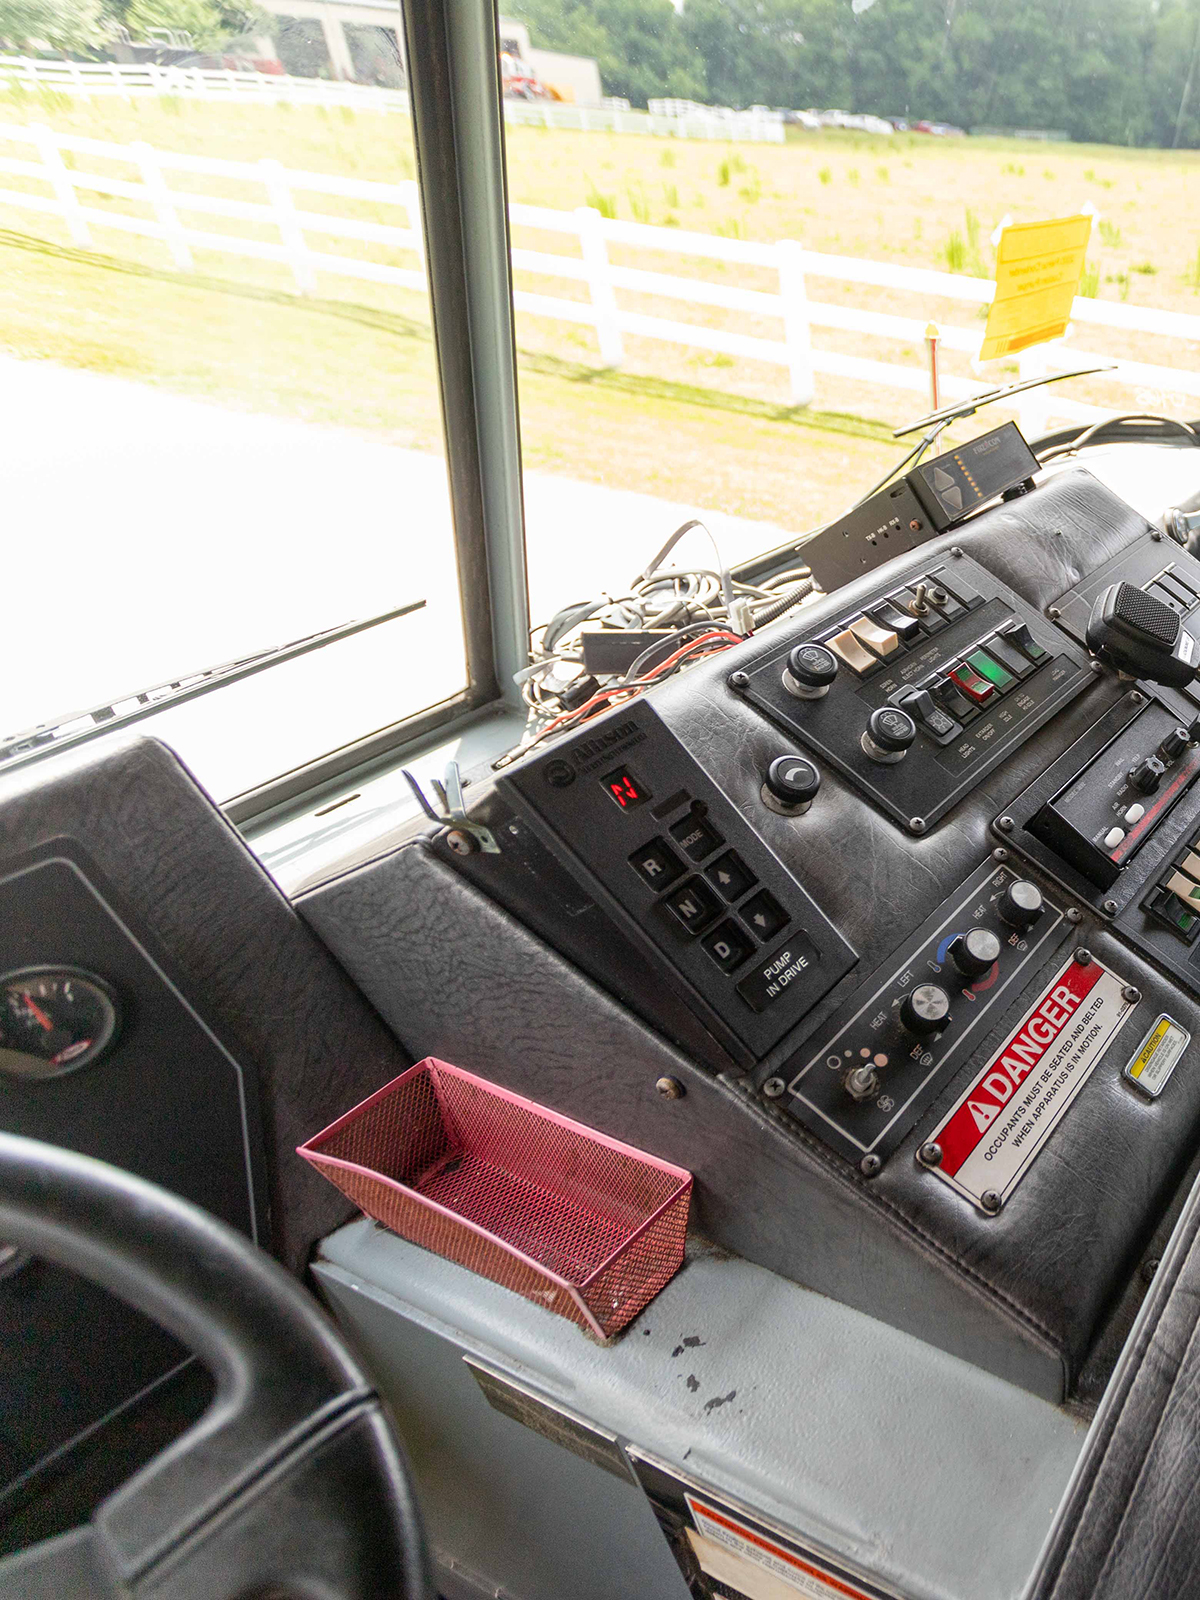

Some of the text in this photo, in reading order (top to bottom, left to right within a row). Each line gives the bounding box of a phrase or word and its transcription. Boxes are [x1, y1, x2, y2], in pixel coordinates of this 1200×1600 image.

[957, 742, 969, 753] HEAD
[960, 745, 976, 759] LIGHTS
[1107, 771, 1124, 789] STANDBY
[1116, 783, 1128, 796] RADIO
[1111, 801, 1119, 810] AIR
[1115, 804, 1127, 816] HORN
[679, 829, 704, 850] MODE
[1092, 824, 1108, 842] MANUAL
[643, 857, 662, 878] R
[992, 871, 1008, 888] RIGHT
[678, 899, 697, 919] N
[972, 904, 987, 919] HEAT
[1007, 932, 1021, 946] DEF
[714, 940, 732, 959] D
[762, 951, 792, 981] PUMP
[765, 956, 809, 998] IN DRIVE
[897, 969, 914, 987] LEFT
[869, 1011, 887, 1030] HEAT
[909, 1044, 925, 1060] DEF
[981, 982, 1080, 1104] DANGER
[1142, 1032, 1161, 1059] CAUTION
[1144, 1052, 1158, 1072] DISENGAGE
[1147, 1066, 1156, 1077] WHEN
[1153, 1052, 1164, 1066] VEHICLE
[982, 996, 1104, 1162] OCCUPANTS MUST BE SEATED AND BELTED
[1011, 1022, 1103, 1148] WHEN APPARATUS IS IN MOTION.
